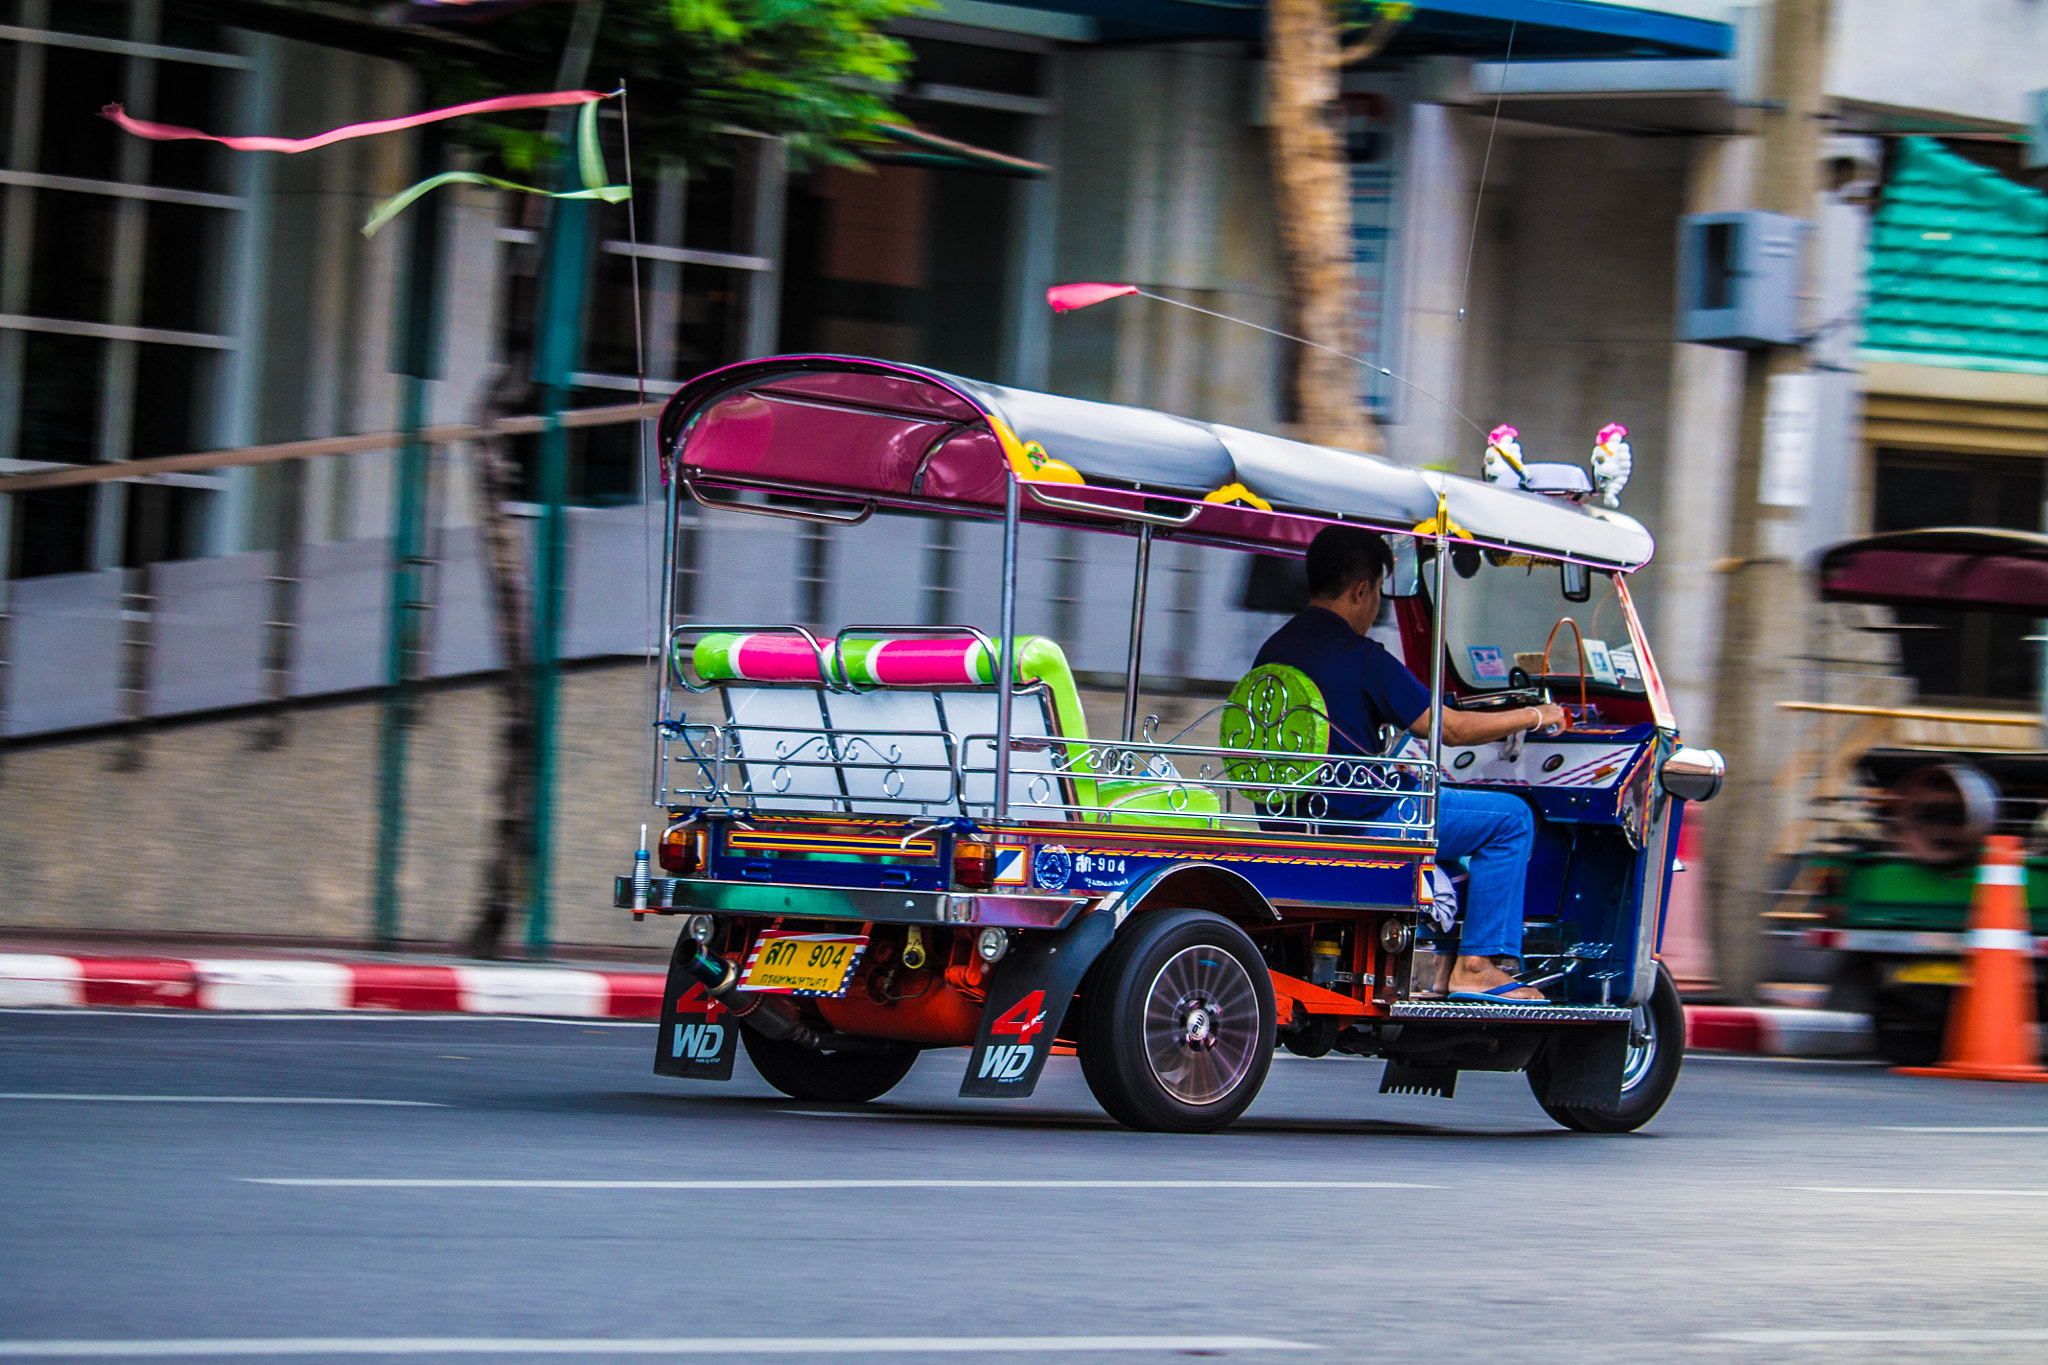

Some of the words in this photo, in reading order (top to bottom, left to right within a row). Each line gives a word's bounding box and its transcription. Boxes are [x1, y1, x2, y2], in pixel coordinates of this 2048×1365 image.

[765, 940, 798, 966] สก
[808, 944, 848, 969] 904
[676, 981, 728, 1023] 4
[990, 990, 1045, 1044] 4
[672, 1023, 725, 1058] WD
[978, 1044, 1035, 1078] WD
